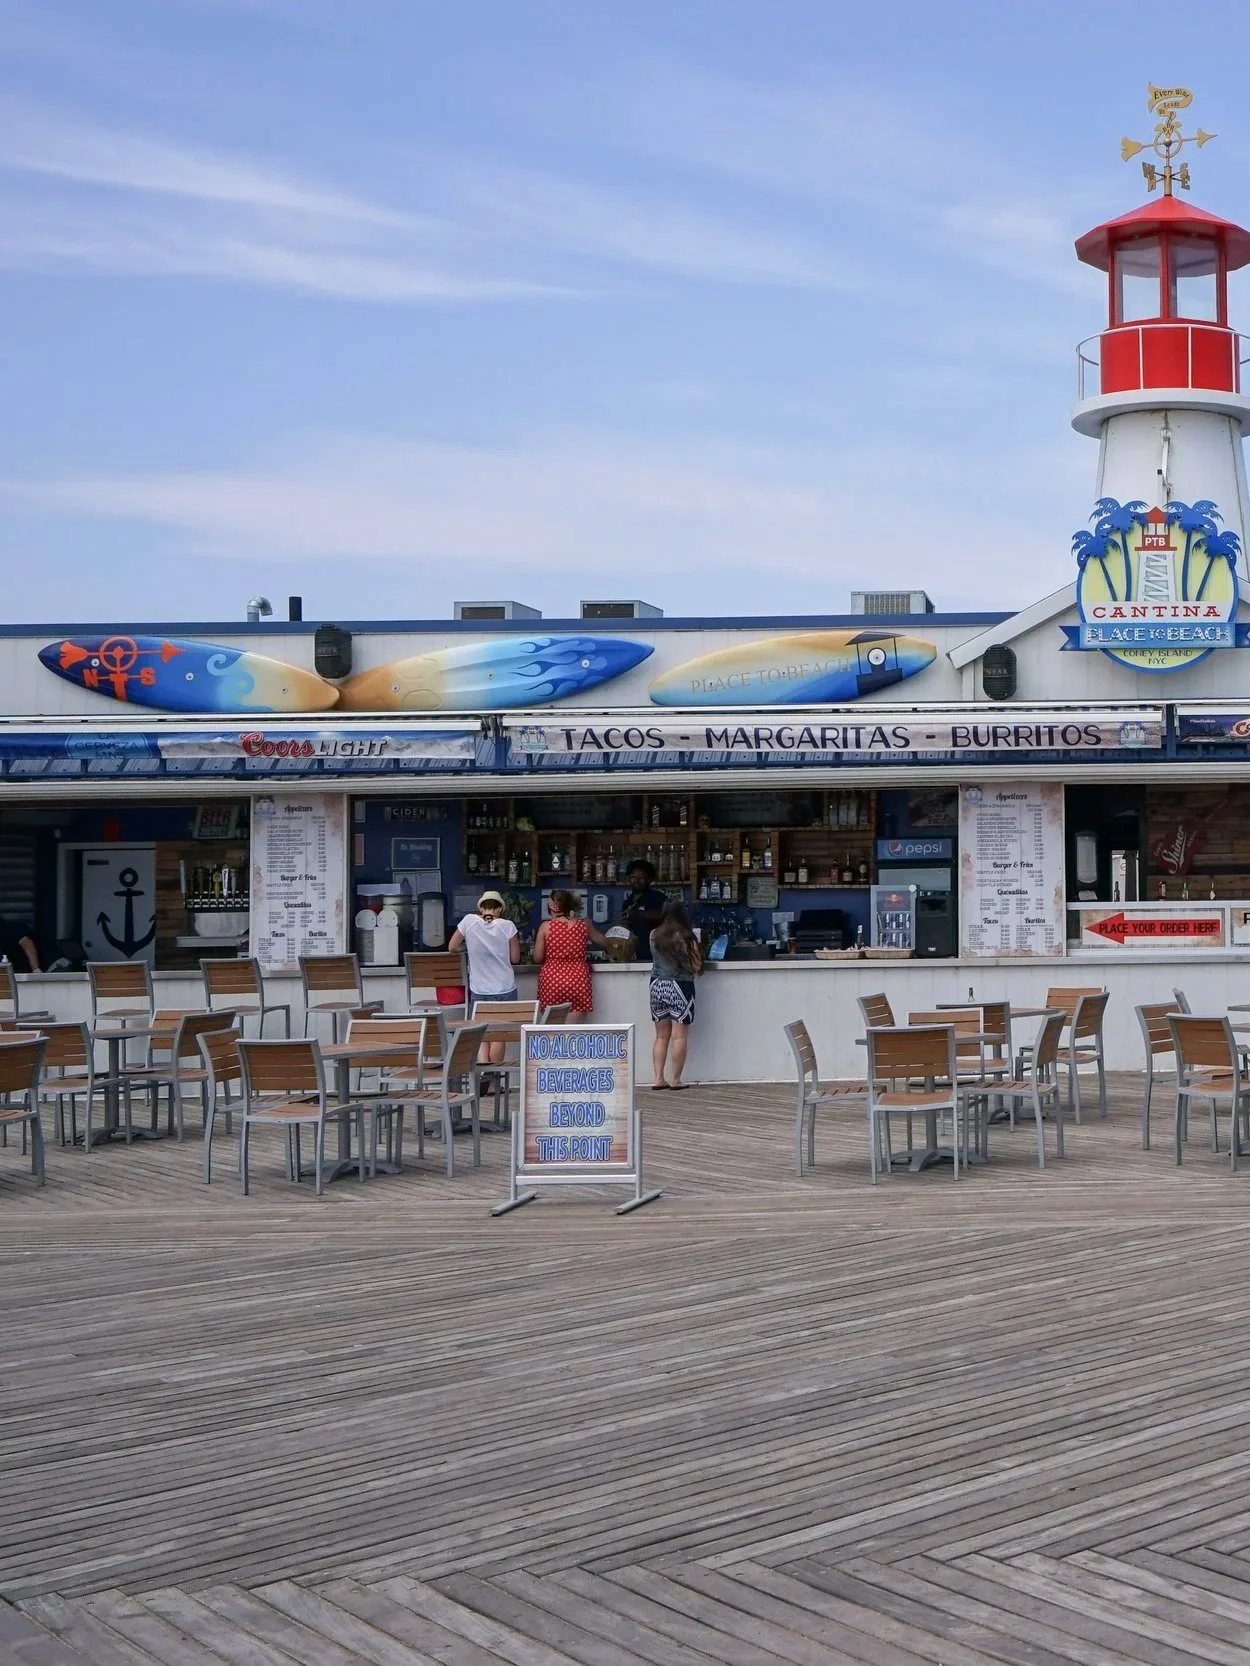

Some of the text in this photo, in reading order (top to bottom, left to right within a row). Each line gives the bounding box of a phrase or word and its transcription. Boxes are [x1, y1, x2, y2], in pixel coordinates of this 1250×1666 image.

[1145, 537, 1165, 546] PTB
[1092, 606, 1221, 619] CANTINA
[1087, 626, 1231, 642] PLACE TO BEACH
[690, 658, 851, 694] PLACE TO BEACH
[239, 731, 388, 757] Coors LIGHT
[561, 727, 665, 749] TACOS
[705, 726, 910, 749] MARGARITAS
[951, 724, 1102, 748] BURRITOS
[392, 808, 425, 816] CIDER
[905, 842, 943, 856] pepsi
[1100, 922, 1217, 933] PLACE YOUR ORDER HERE
[528, 1033, 627, 1060] NO ALCOHOLIC
[537, 1067, 614, 1093] BEVERAGES
[550, 1102, 606, 1127] BEYOND
[536, 1135, 613, 1162] THIS POINT
